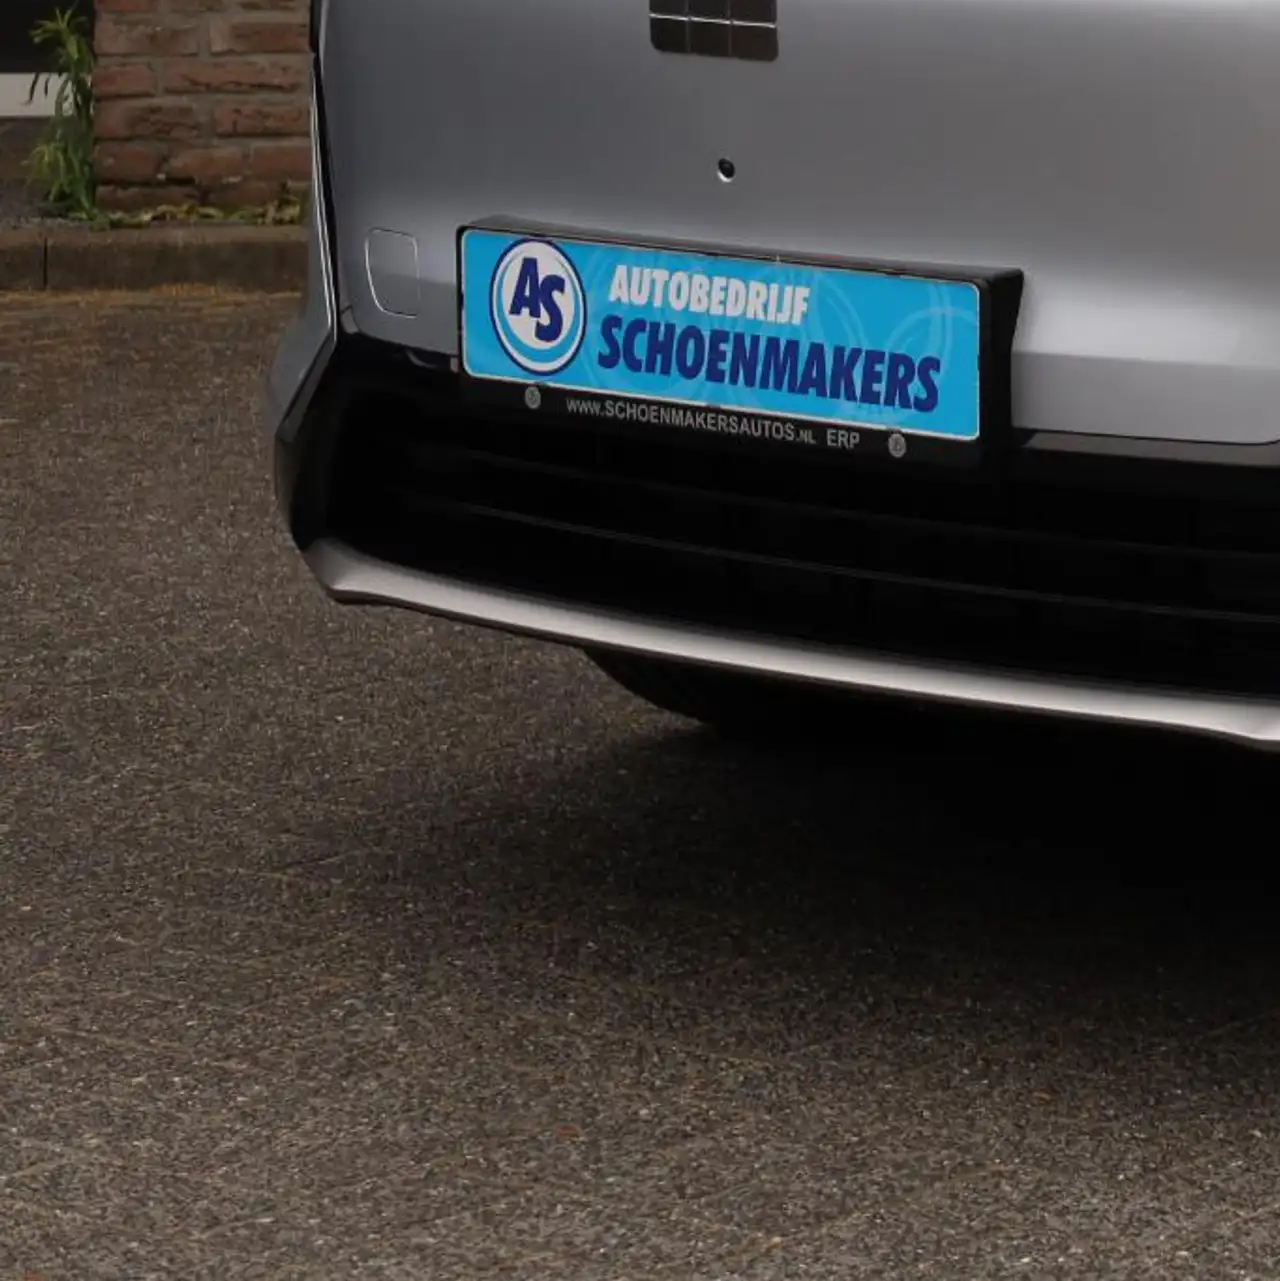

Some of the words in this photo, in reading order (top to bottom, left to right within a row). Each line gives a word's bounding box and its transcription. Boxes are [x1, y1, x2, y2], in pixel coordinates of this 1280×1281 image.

[508, 256, 566, 342] AS
[609, 265, 811, 325] AUTOBEDRIJF
[597, 314, 941, 413] SCHOENMAKERS
[826, 428, 860, 449] ERP
